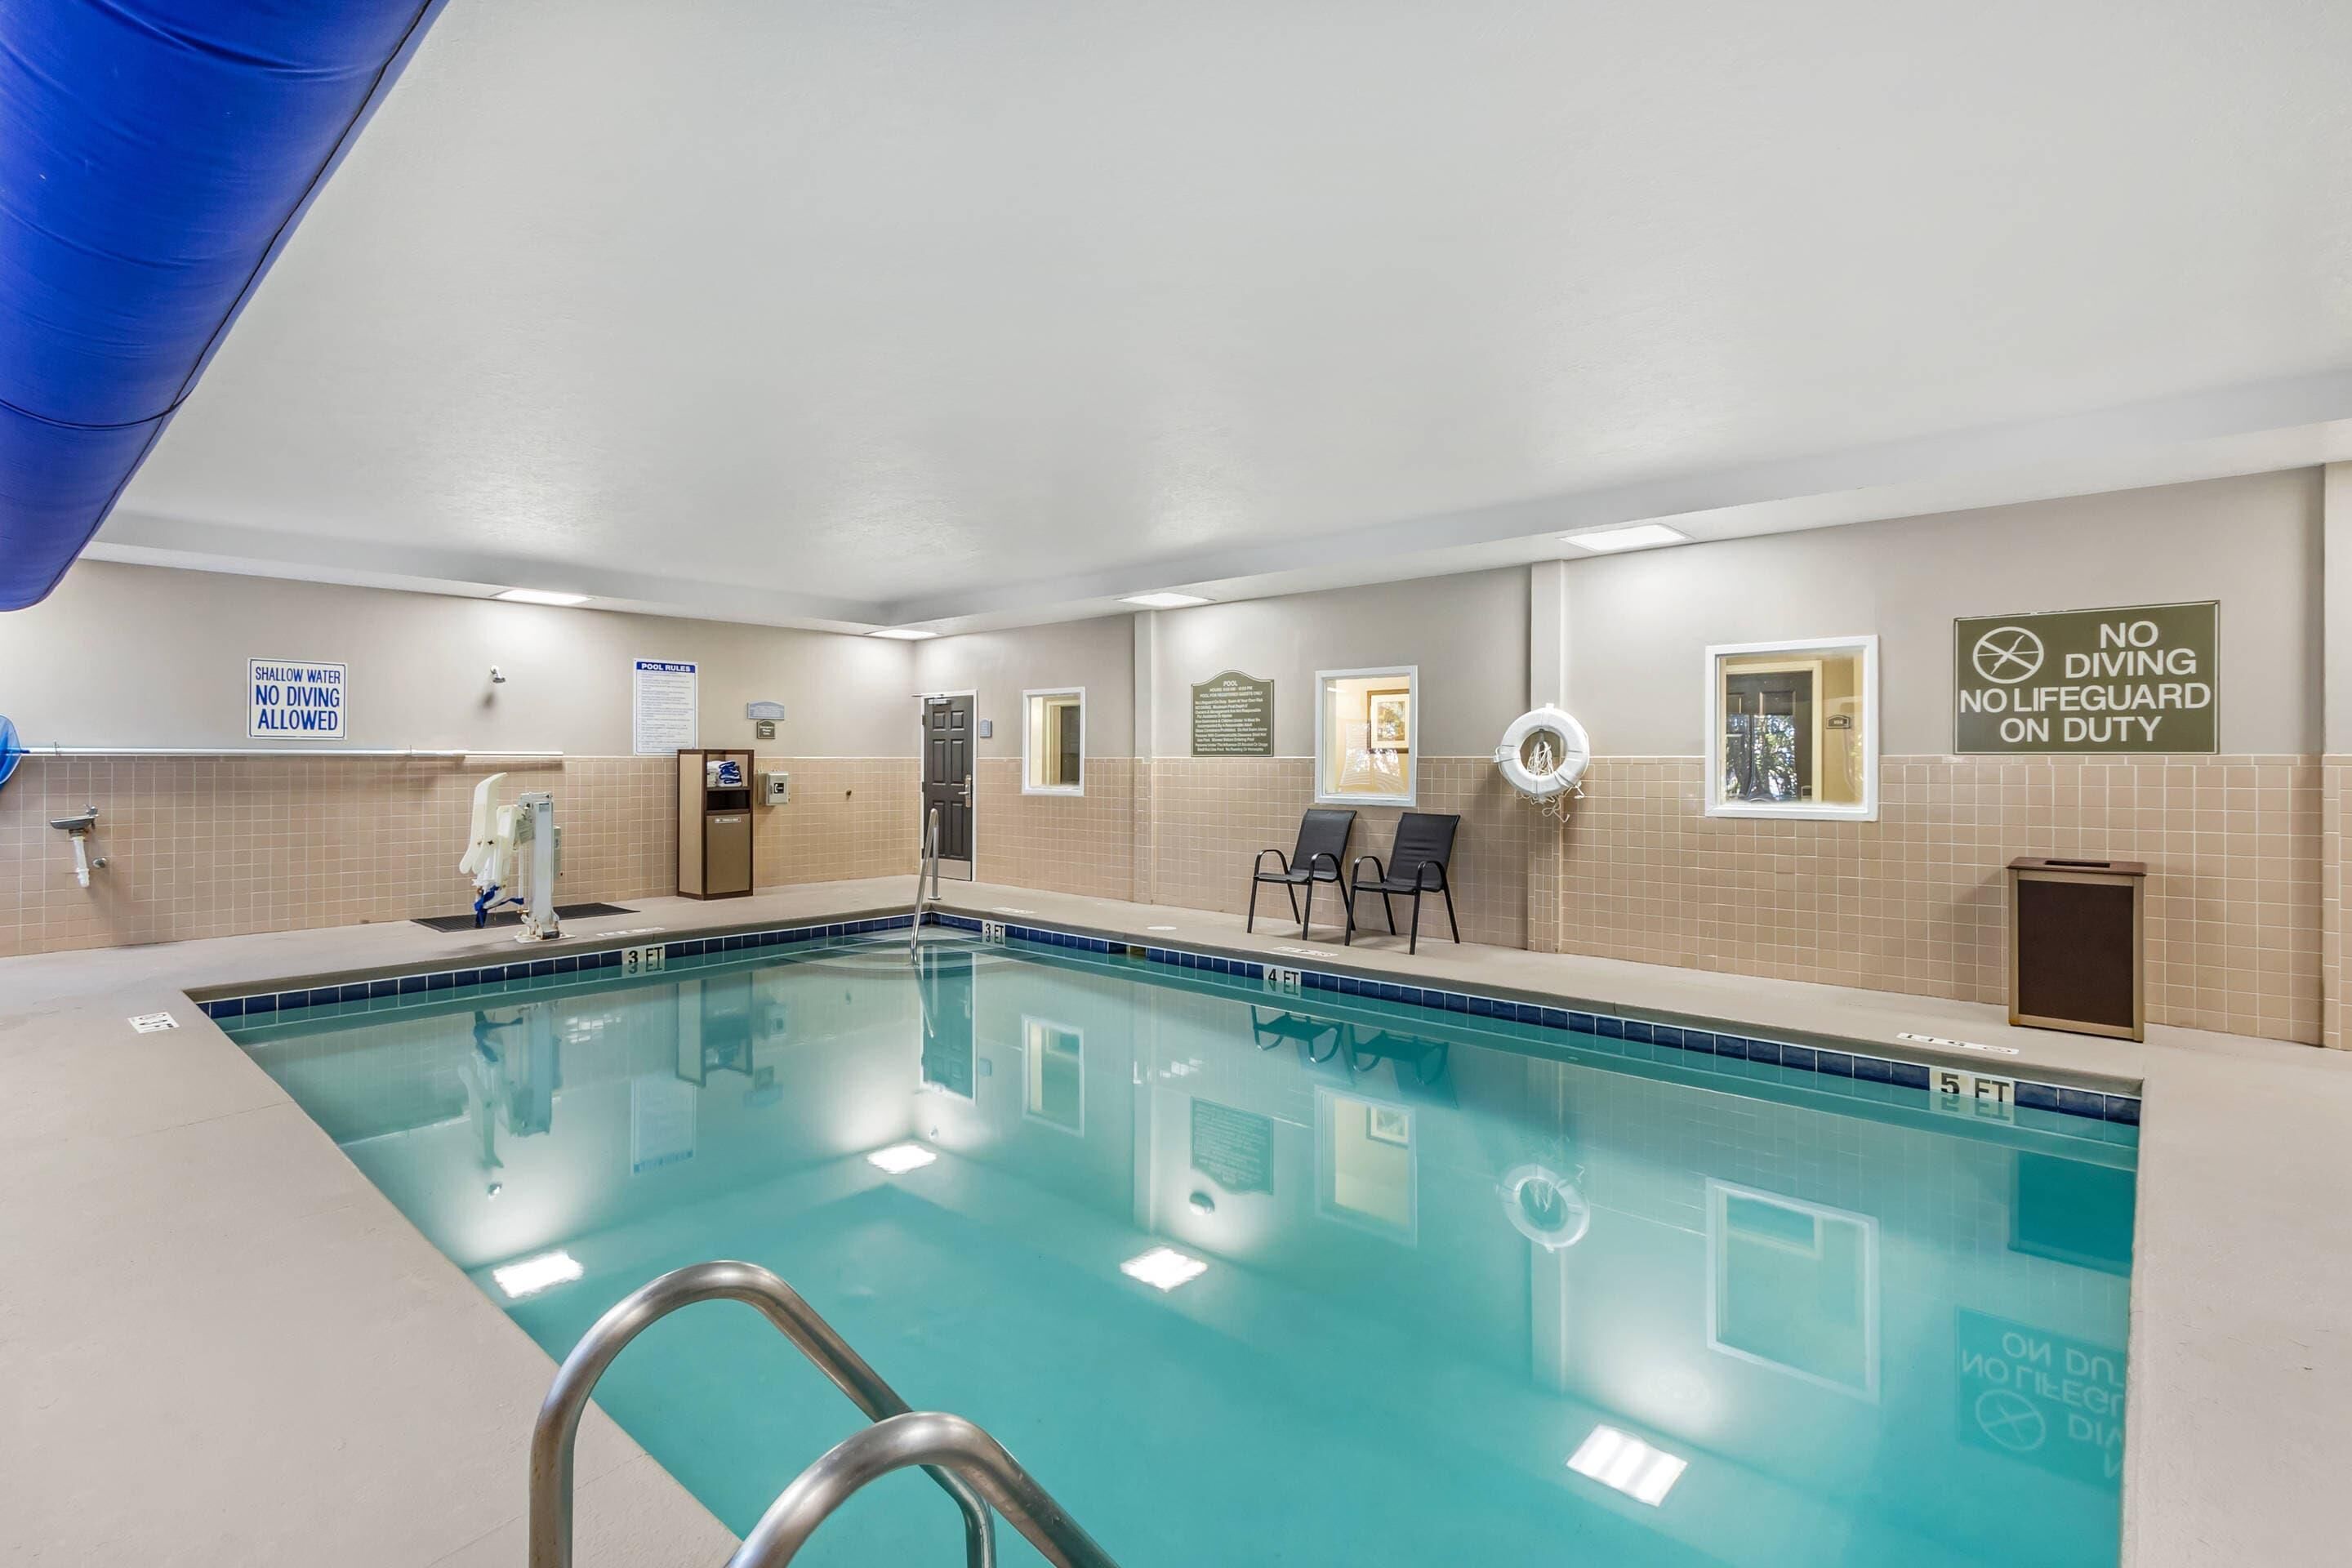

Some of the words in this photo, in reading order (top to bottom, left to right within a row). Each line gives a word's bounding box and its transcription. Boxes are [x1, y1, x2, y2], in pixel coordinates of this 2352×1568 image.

[2100, 621, 2159, 649] NO
[255, 666, 304, 682] SHALLOW
[306, 669, 341, 684] WATER
[2065, 648, 2197, 679] DIVING
[256, 684, 279, 706] NO
[287, 686, 340, 707] DIVING
[1960, 688, 2008, 713] NO
[2013, 682, 2212, 712] LIFEGUARD
[257, 708, 338, 731] ALLOWED
[2000, 717, 2049, 743] ON
[2064, 715, 2163, 742] DUTY
[985, 923, 991, 934] 3
[994, 924, 1004, 935] FT
[628, 950, 639, 964] 3
[645, 947, 663, 960] FT
[1267, 968, 1277, 982] 4
[1283, 970, 1299, 986] FT
[1940, 1072, 1960, 1094] 5
[1974, 1077, 2010, 1102] FT
